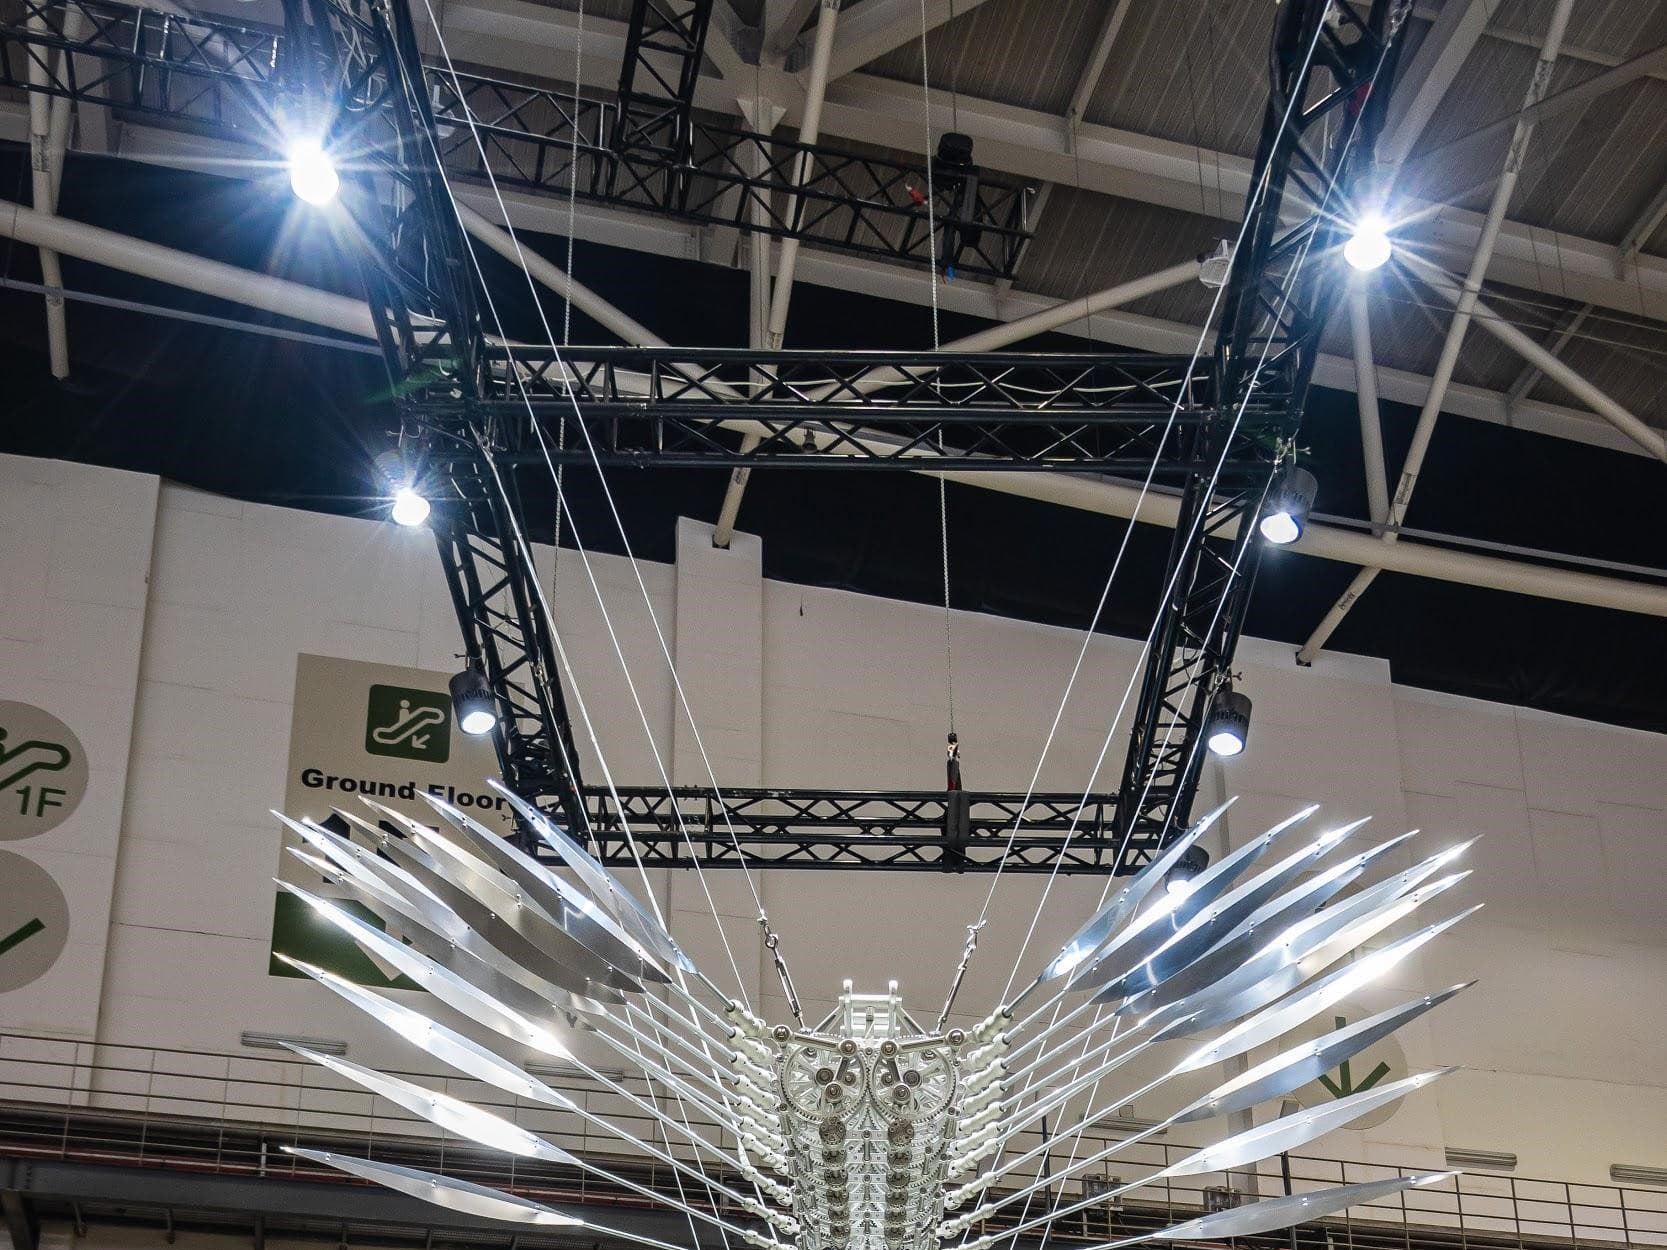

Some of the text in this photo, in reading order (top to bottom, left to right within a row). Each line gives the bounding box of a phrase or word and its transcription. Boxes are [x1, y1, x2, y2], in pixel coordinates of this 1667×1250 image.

[16, 785, 67, 817] 1F
[301, 768, 508, 811] Ground Floor
